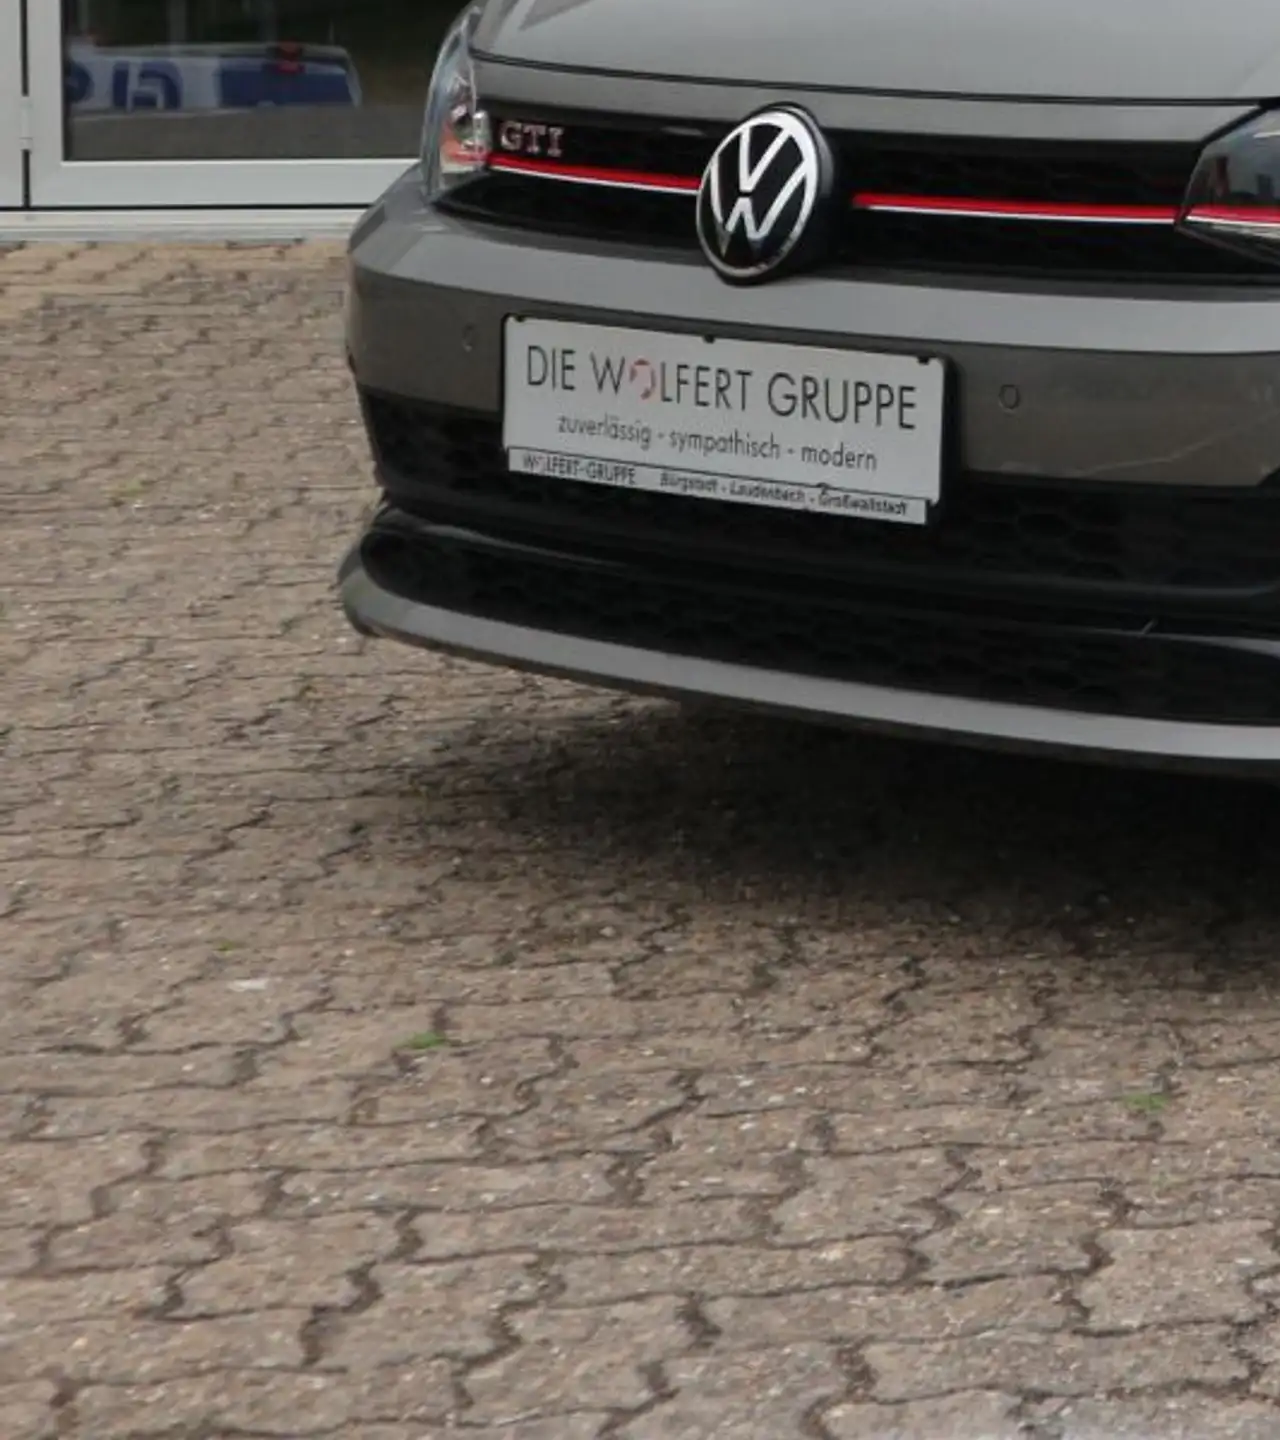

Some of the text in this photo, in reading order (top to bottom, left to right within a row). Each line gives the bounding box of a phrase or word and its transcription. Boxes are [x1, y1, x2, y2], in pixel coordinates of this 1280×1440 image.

[499, 119, 566, 158] GTI
[526, 345, 917, 431] DIE WOLFERT GRUPPE
[557, 412, 878, 472] zuverlässig sympathisch modern
[522, 453, 638, 486] WLFERT-GRUPPE
